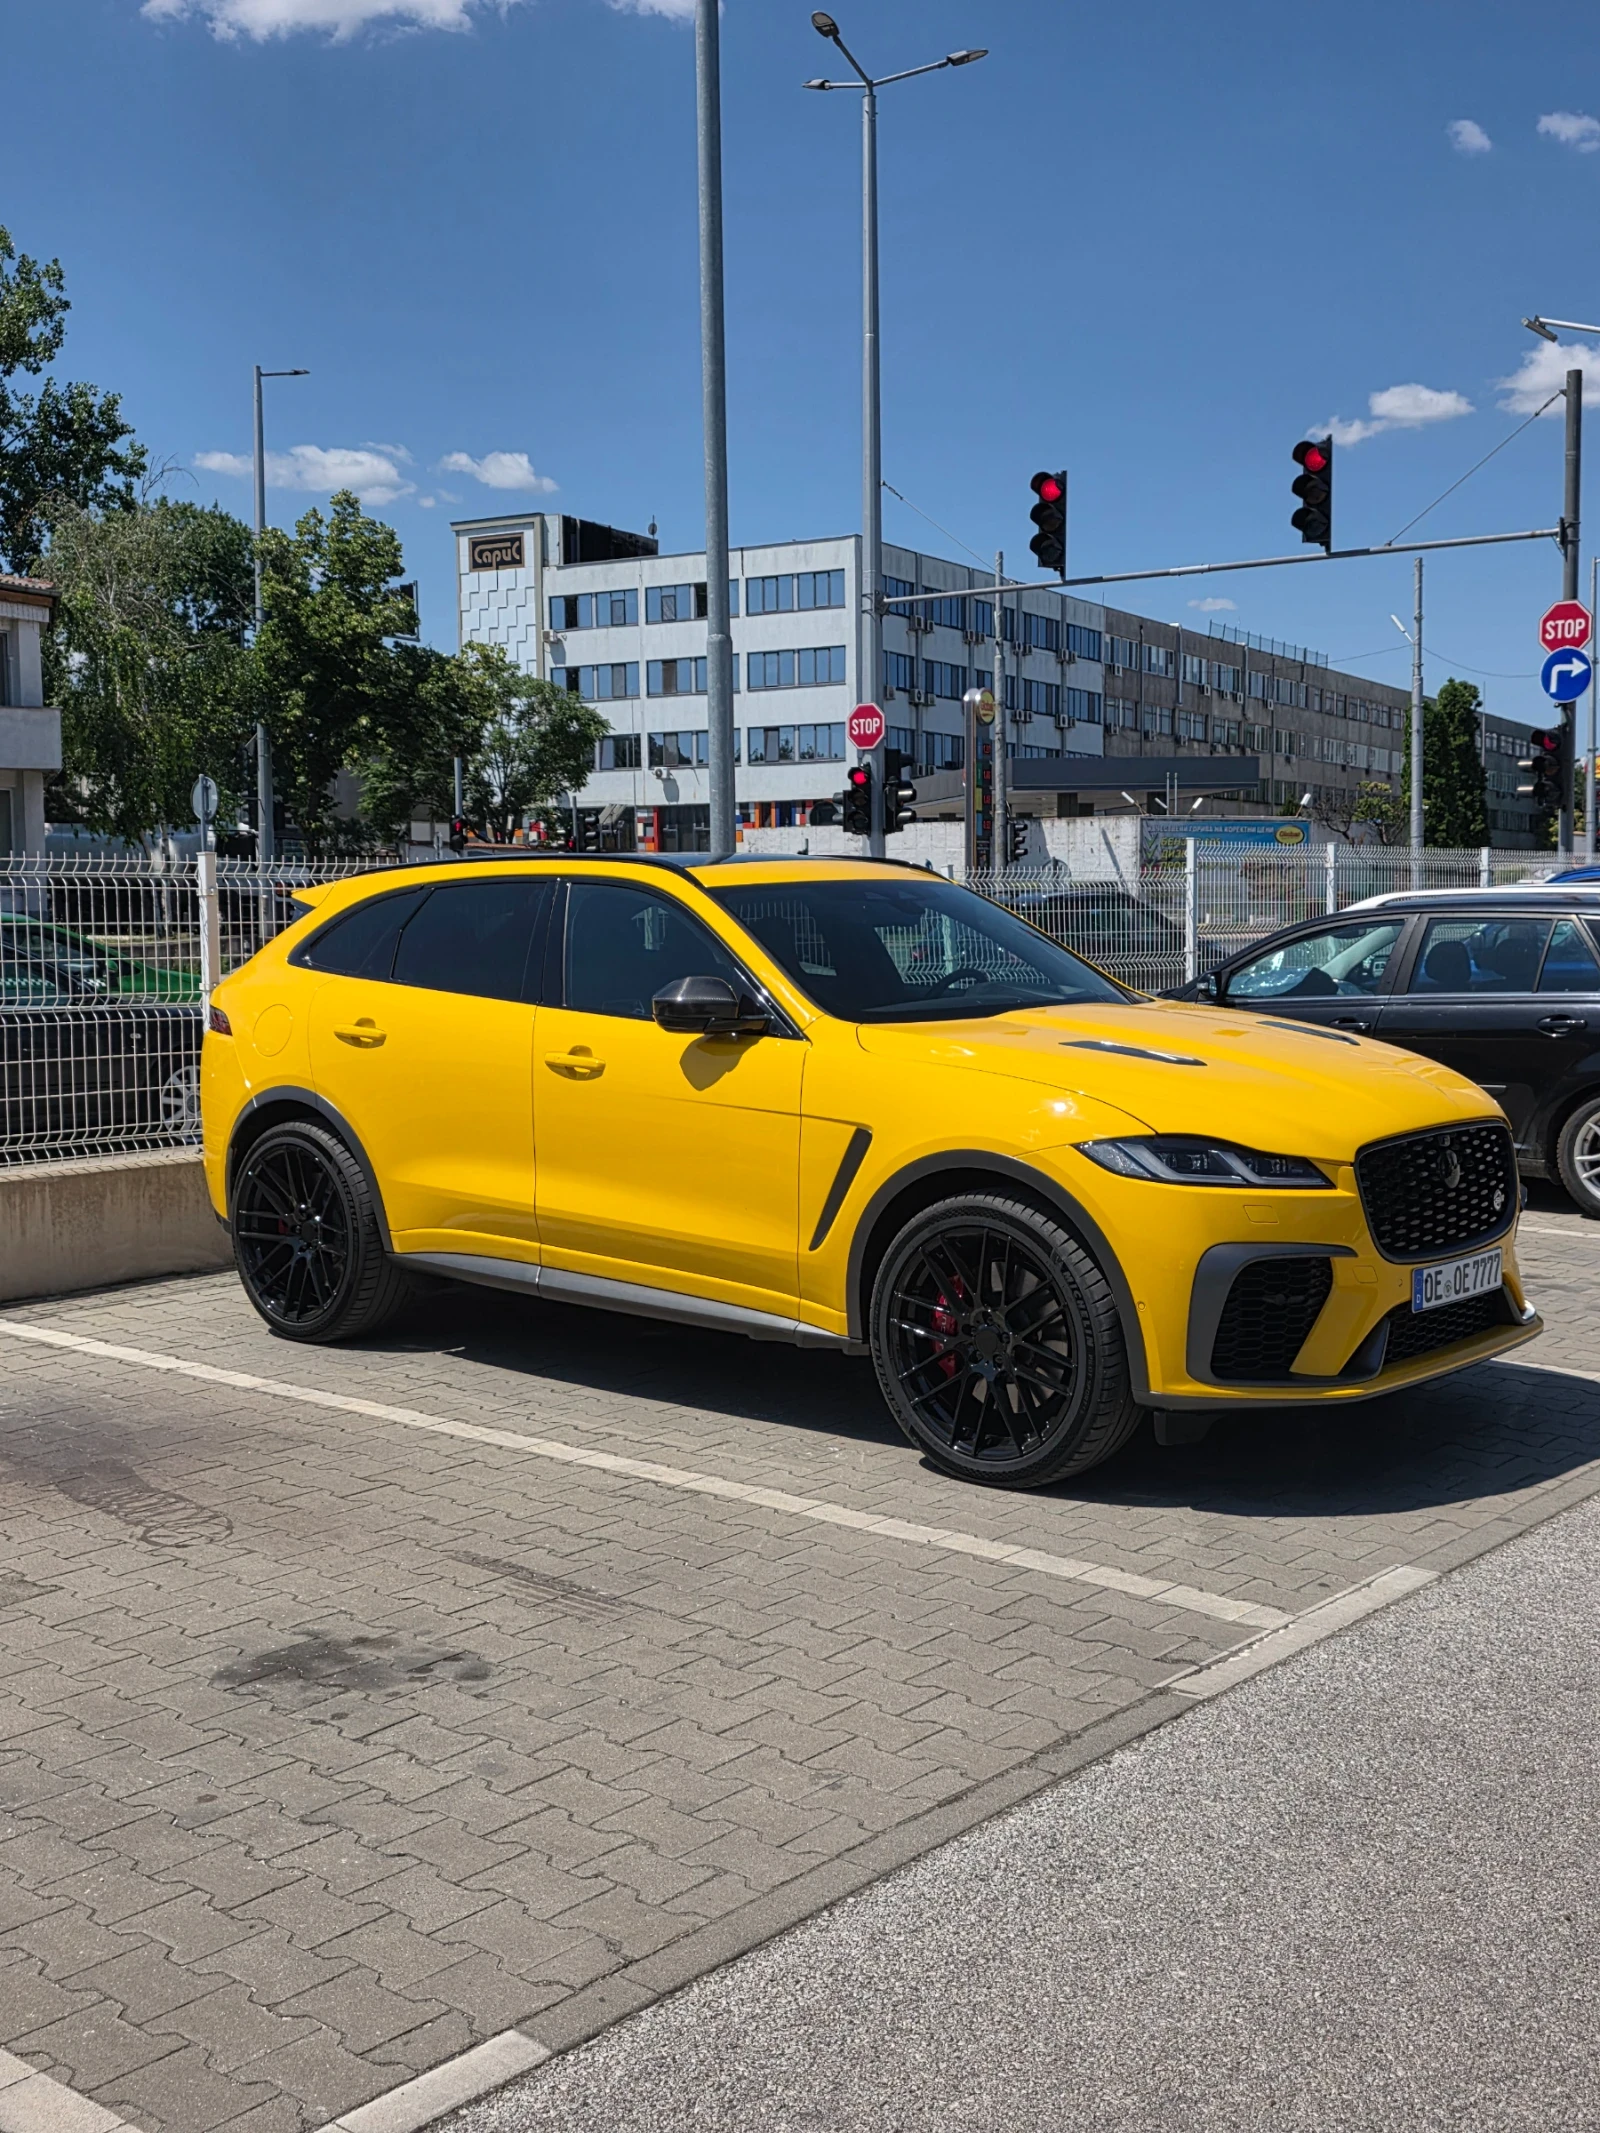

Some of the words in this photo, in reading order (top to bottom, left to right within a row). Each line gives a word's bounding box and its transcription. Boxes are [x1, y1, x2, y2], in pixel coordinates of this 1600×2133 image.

[1545, 618, 1586, 640] STOP
[851, 717, 881, 735] STOP
[1425, 1270, 1443, 1303] OE
[1062, 1270, 1094, 1347] MICHELIN
[1416, 1294, 1421, 1303] D
